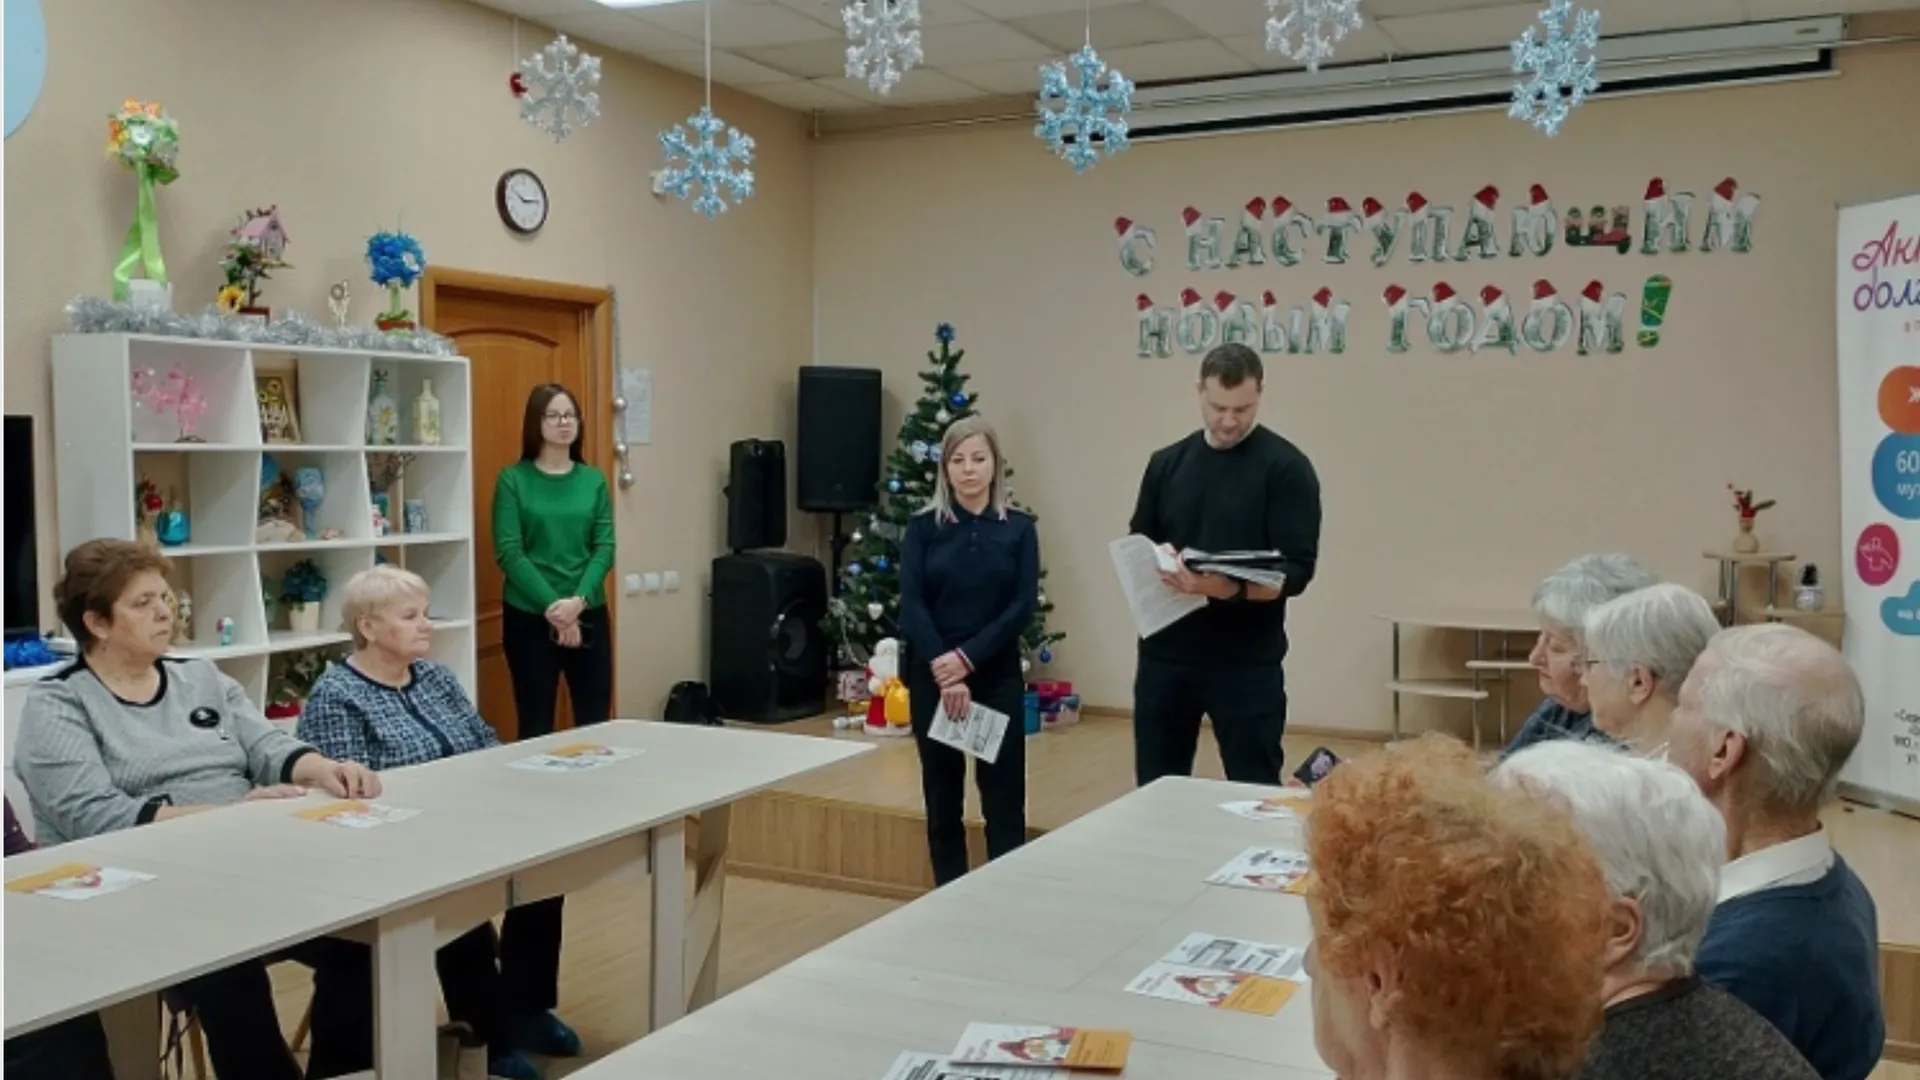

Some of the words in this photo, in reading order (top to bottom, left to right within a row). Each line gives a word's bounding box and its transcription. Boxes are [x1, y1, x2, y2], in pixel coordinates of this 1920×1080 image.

[1115, 218, 1156, 276] С
[1182, 179, 1761, 268] НАСТУПАЮЩИМ
[1136, 288, 1350, 358] НОВЫМ
